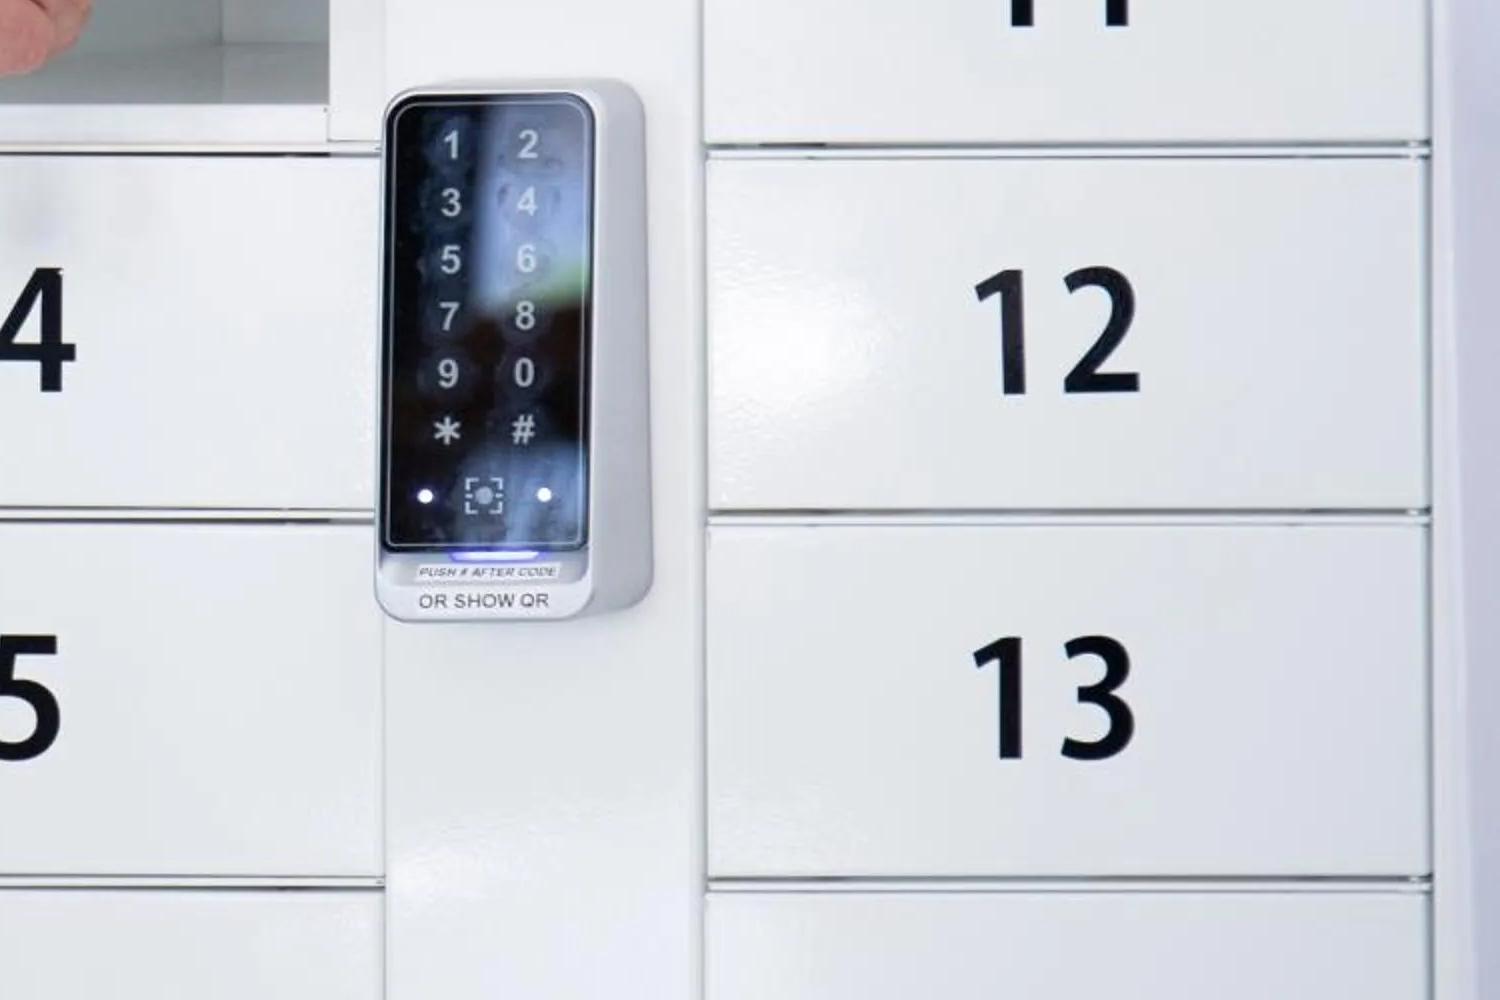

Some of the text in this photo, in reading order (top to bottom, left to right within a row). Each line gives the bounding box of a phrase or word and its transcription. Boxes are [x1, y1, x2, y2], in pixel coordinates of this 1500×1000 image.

[443, 130, 539, 159] 1 2
[441, 187, 538, 217] 3 4
[441, 244, 537, 274] 5 6
[440, 301, 535, 331] 7 8
[975, 266, 1141, 395] 12
[438, 358, 535, 388] 9 0
[419, 567, 457, 577] PUSH
[472, 567, 515, 577] AFTER
[518, 566, 557, 577] CODE
[419, 593, 549, 609] OR SHOW QR
[973, 635, 1135, 762] 13
